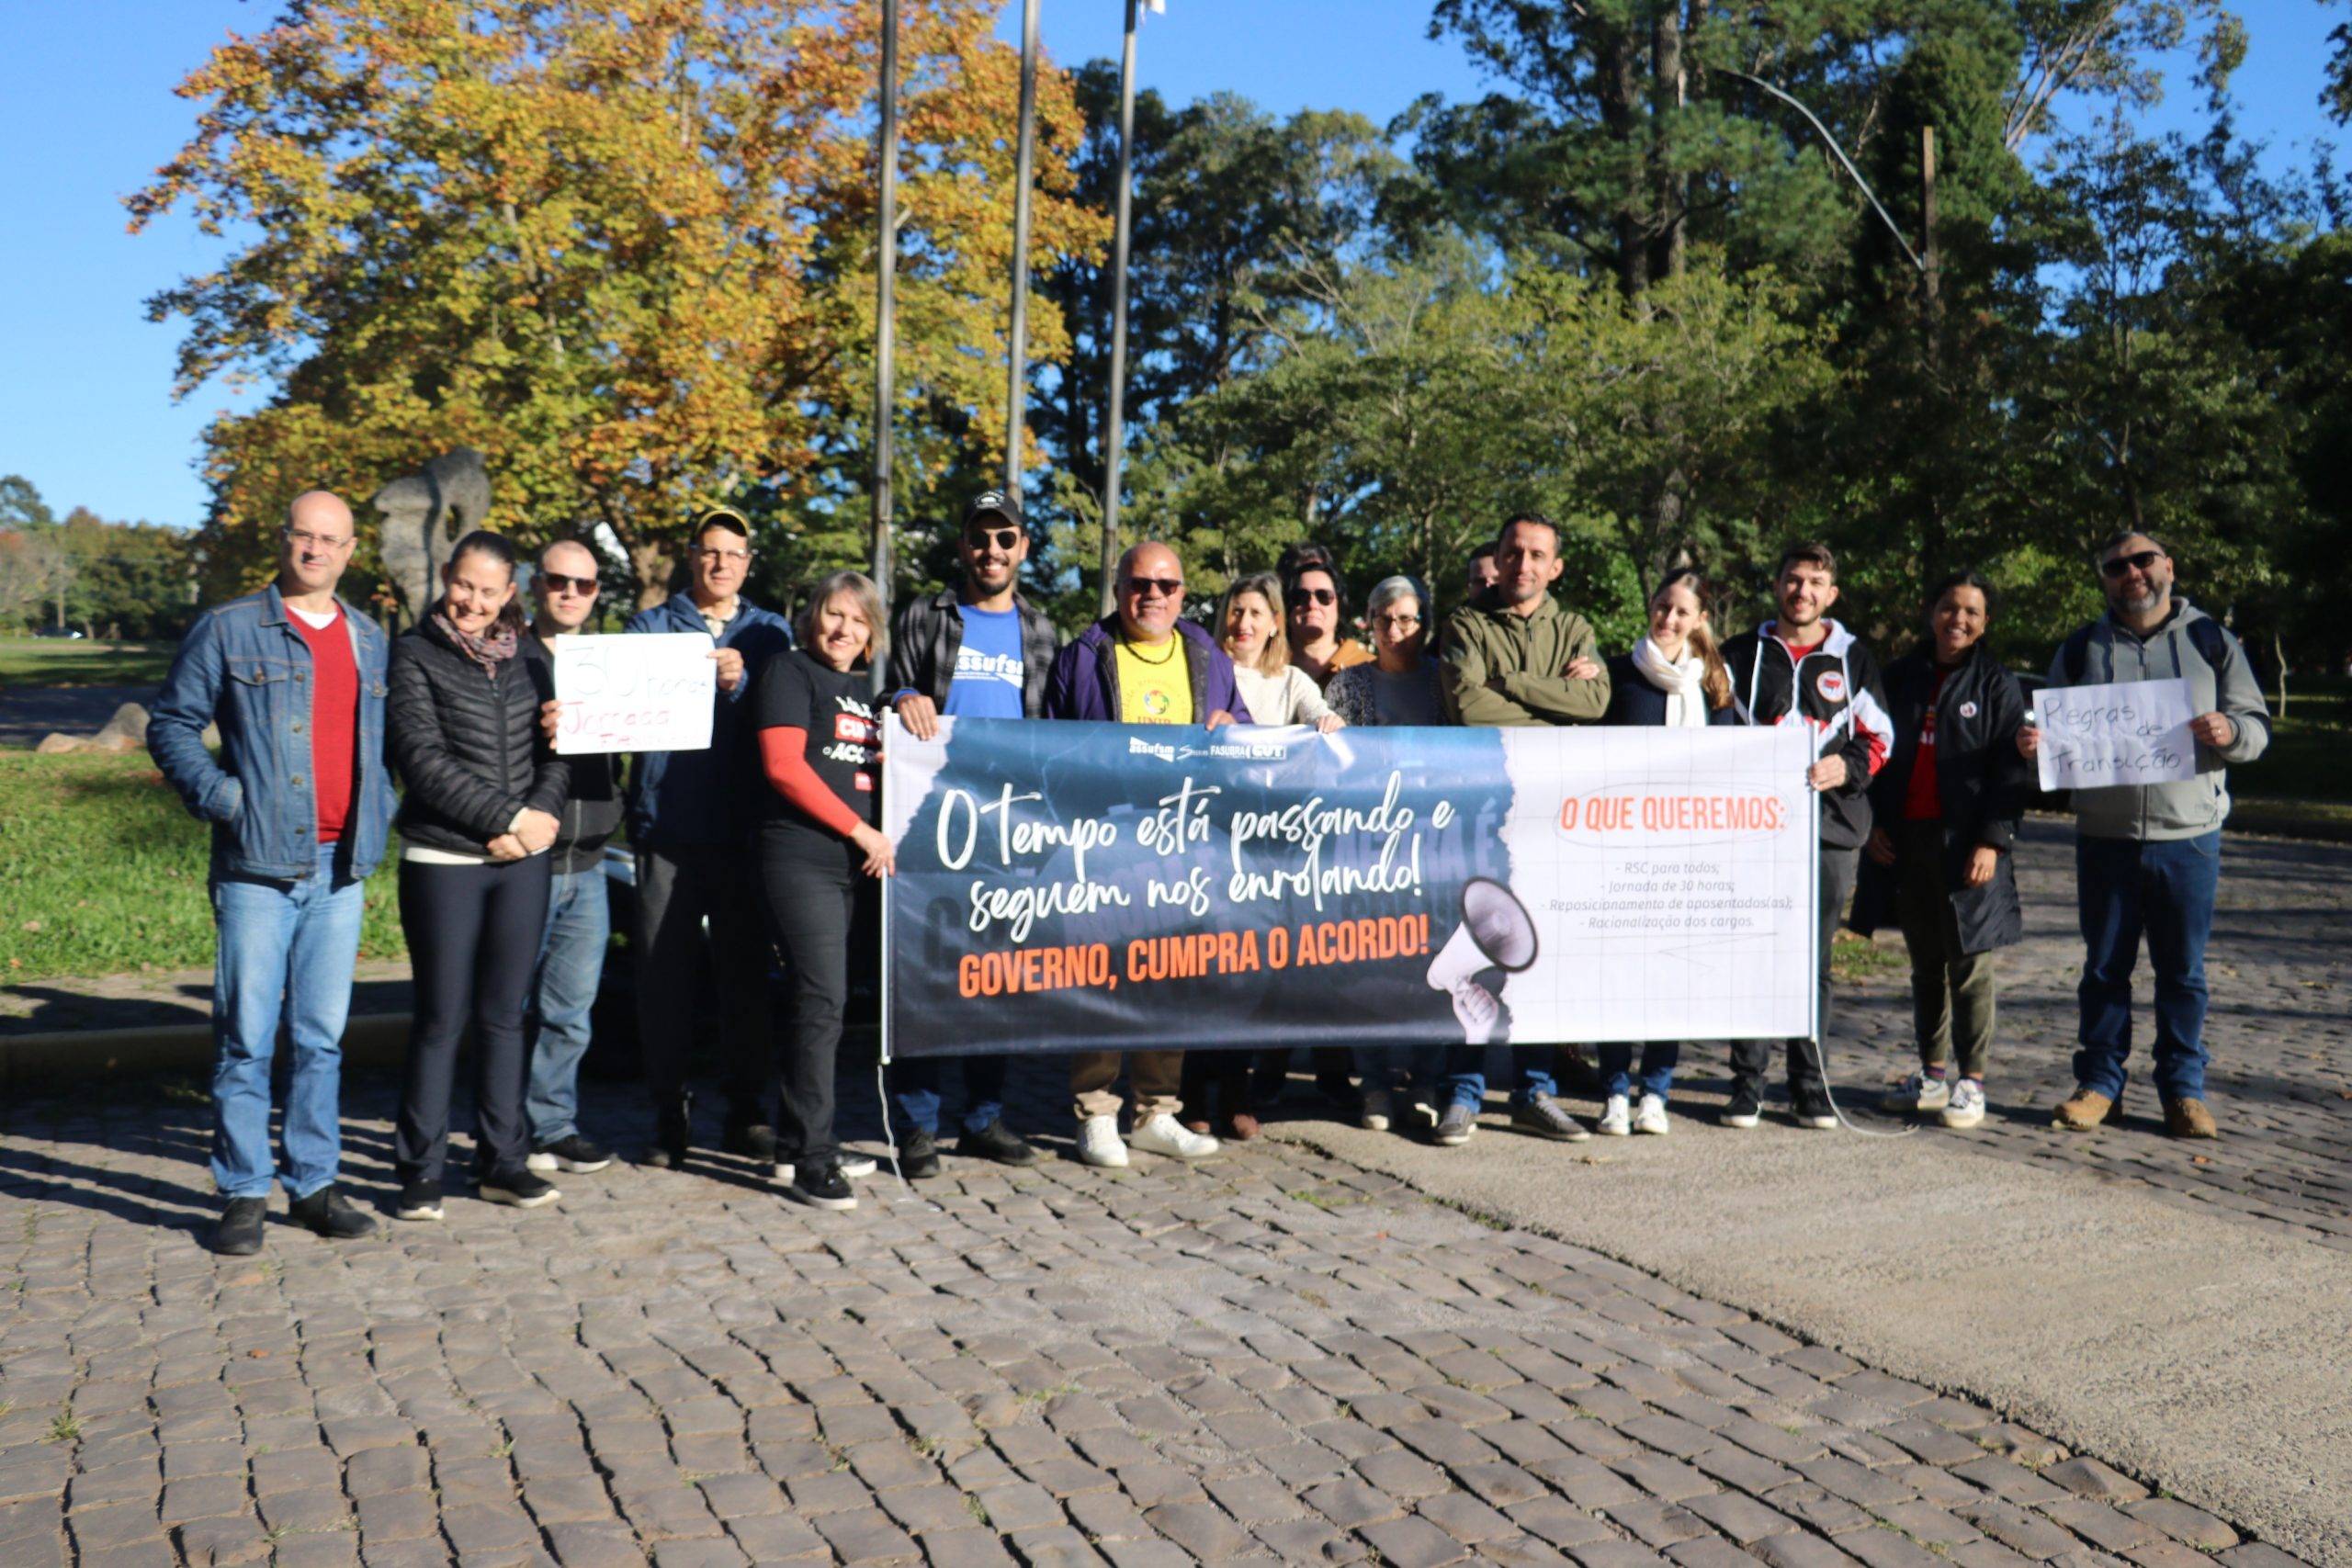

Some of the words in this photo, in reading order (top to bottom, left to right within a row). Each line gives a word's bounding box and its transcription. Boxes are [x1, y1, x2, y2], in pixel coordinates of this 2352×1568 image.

[2042, 696, 2136, 732] Regras
[2136, 721, 2163, 738] de
[937, 789, 978, 870] O
[979, 783, 1118, 884] tempo
[1136, 776, 1222, 855] está
[1231, 770, 1415, 874] passando
[1431, 799, 1455, 829] e
[1561, 797, 1578, 829] O
[1585, 797, 1634, 832] QUE
[1642, 796, 1786, 832] QUEREMOS:
[1624, 863, 1648, 874] RSC
[1652, 864, 1679, 876] para
[1683, 862, 1720, 875] todos;
[969, 880, 1131, 943] seguem
[1148, 866, 1212, 917] nos
[1228, 829, 1422, 912] enrolando!
[1608, 881, 1657, 895] Jornada
[1661, 880, 1677, 892] de
[1679, 880, 1693, 892] 30
[1697, 880, 1735, 894] horas;
[1549, 898, 1665, 914] Reposicionamento
[1668, 897, 1682, 910] de
[1686, 896, 1793, 912] aposentados(as);
[1589, 915, 1680, 931] Racionalização
[1685, 915, 1706, 928] dos
[1710, 917, 1755, 931] cargos.
[958, 942, 1118, 998] GOVERNO,
[1127, 930, 1260, 983] CUMPRA
[1268, 926, 1290, 972] O
[1296, 914, 1429, 968] ACORDO!
